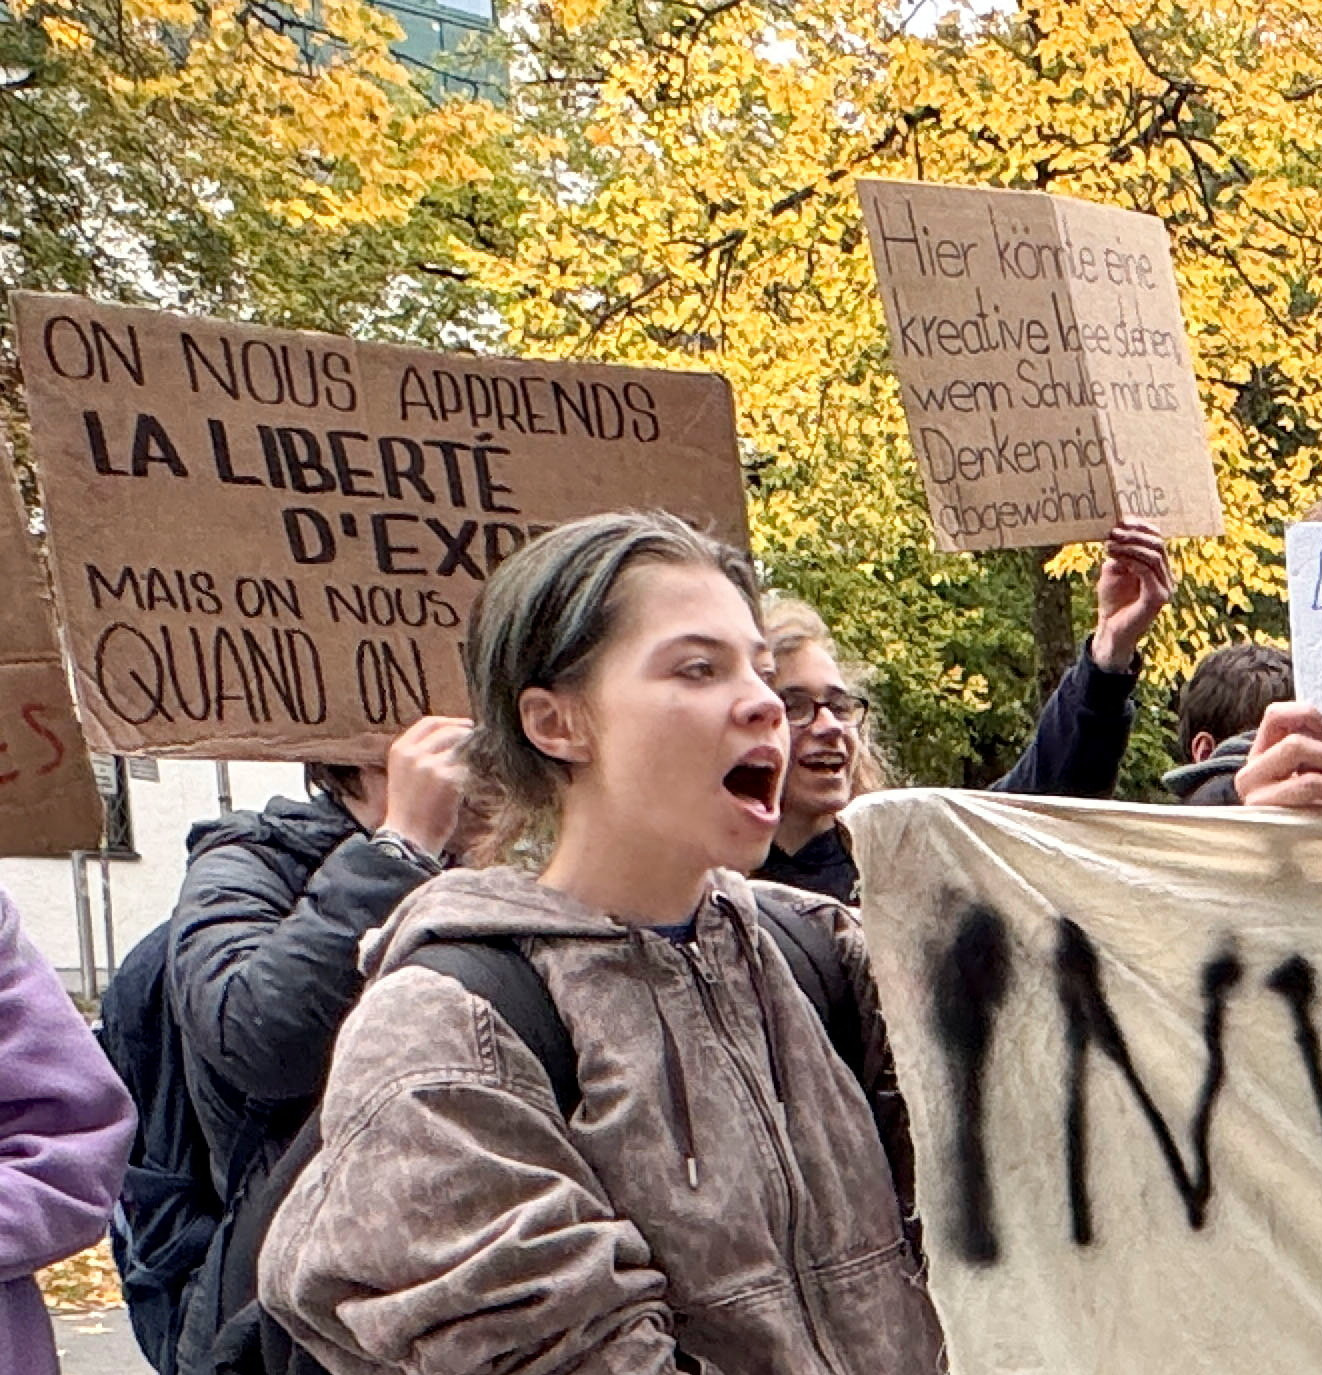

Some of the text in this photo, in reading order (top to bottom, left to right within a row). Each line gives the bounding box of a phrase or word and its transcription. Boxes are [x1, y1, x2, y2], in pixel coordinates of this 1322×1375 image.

[873, 196, 979, 279] Hier
[988, 203, 1099, 283] könnte
[893, 287, 1049, 359] kreative
[44, 315, 661, 443] ON NOUS APPRENDS
[1016, 358, 1108, 409] Schule
[83, 409, 522, 513] LA LIBERTÉ
[919, 417, 1058, 485] Denken
[940, 469, 1107, 547] abgewöhnt
[87, 562, 461, 629] MAIS ON NOUS
[94, 620, 431, 727] QUAND ON
